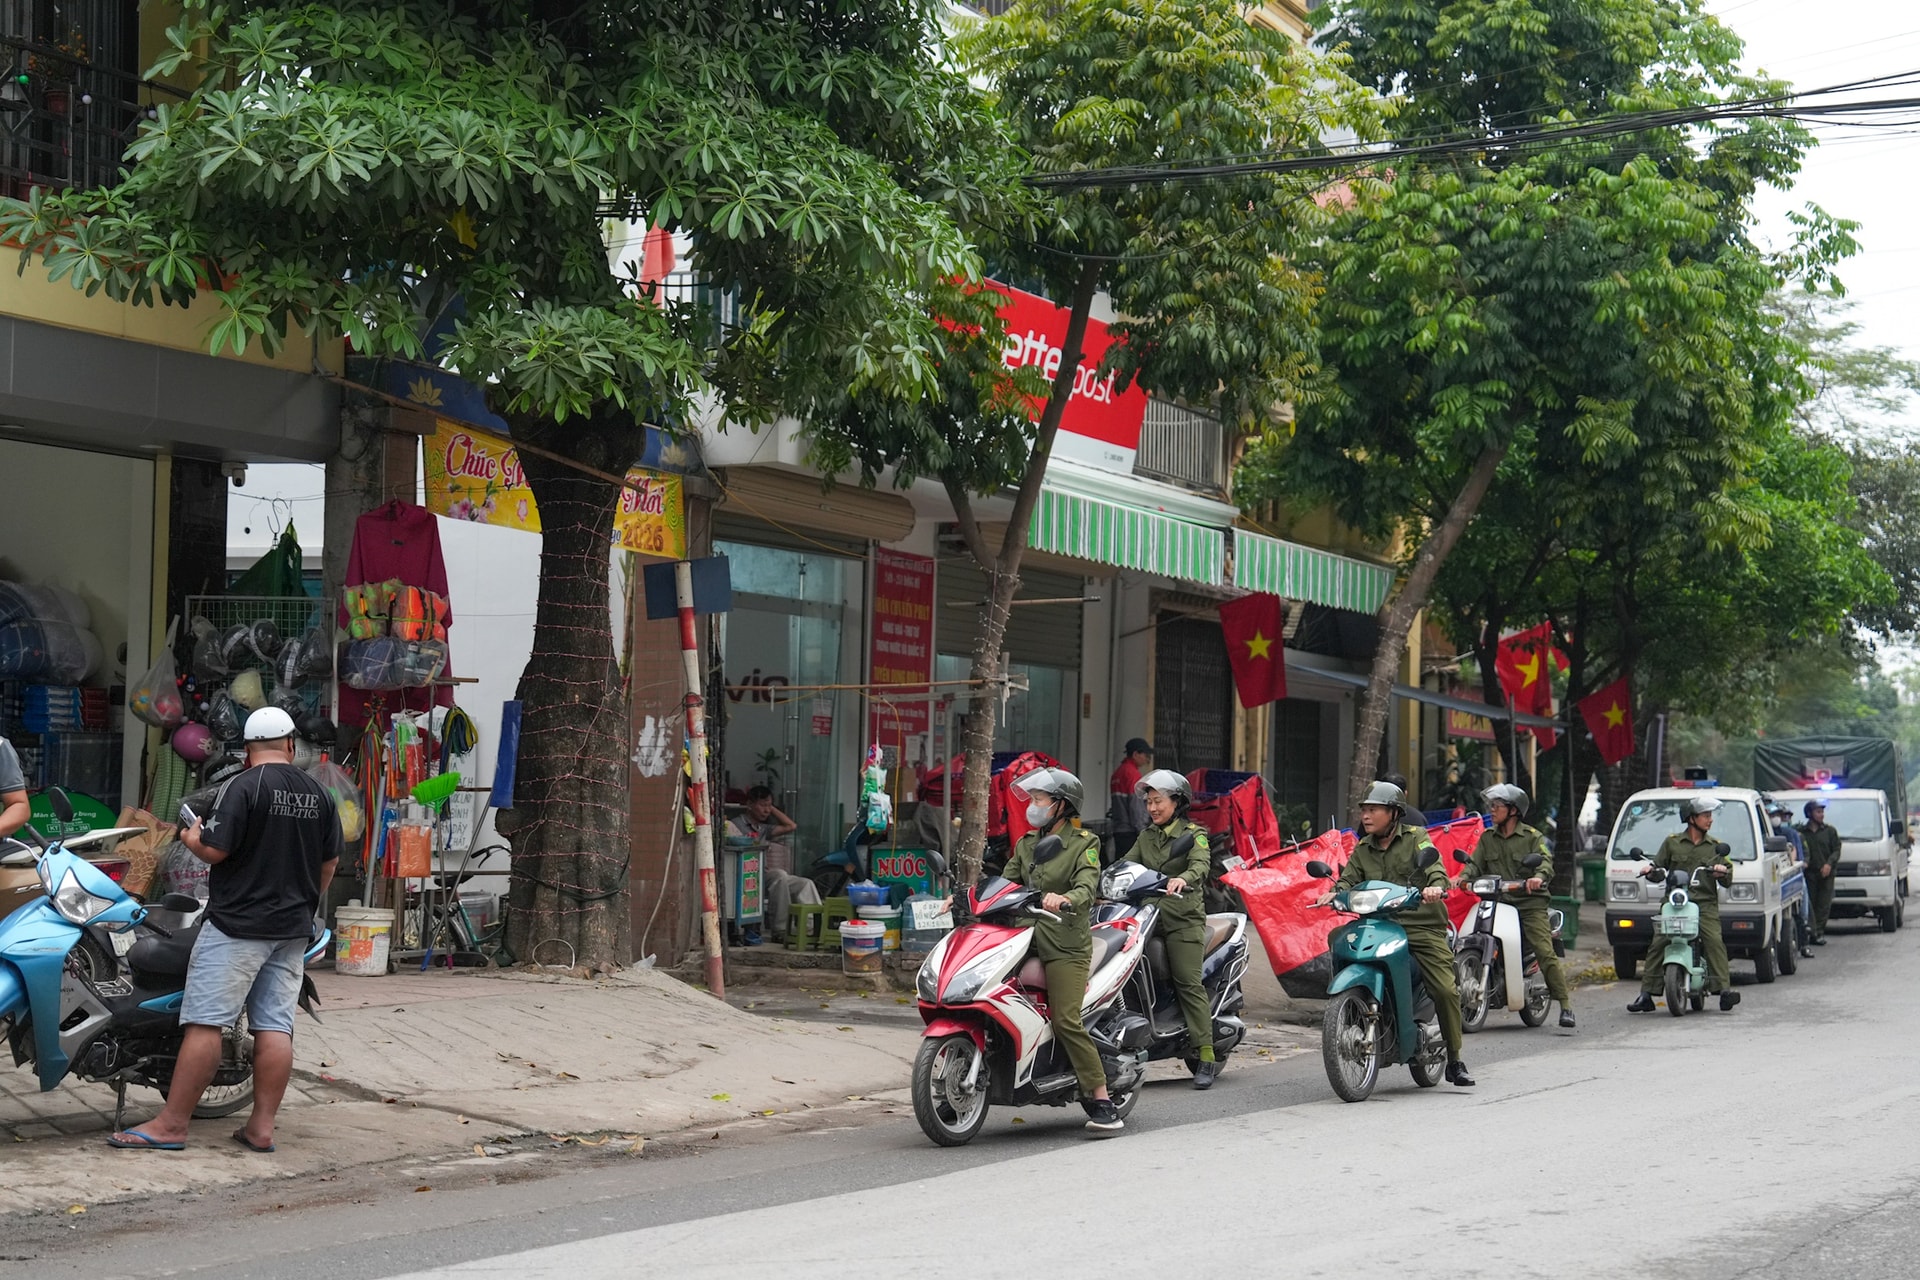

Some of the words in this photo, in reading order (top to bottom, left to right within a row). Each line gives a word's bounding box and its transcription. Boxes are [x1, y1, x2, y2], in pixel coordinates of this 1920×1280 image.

[445, 432, 498, 479] Chúc
[622, 519, 664, 552] 2026
[877, 852, 927, 878] NƯỚC
